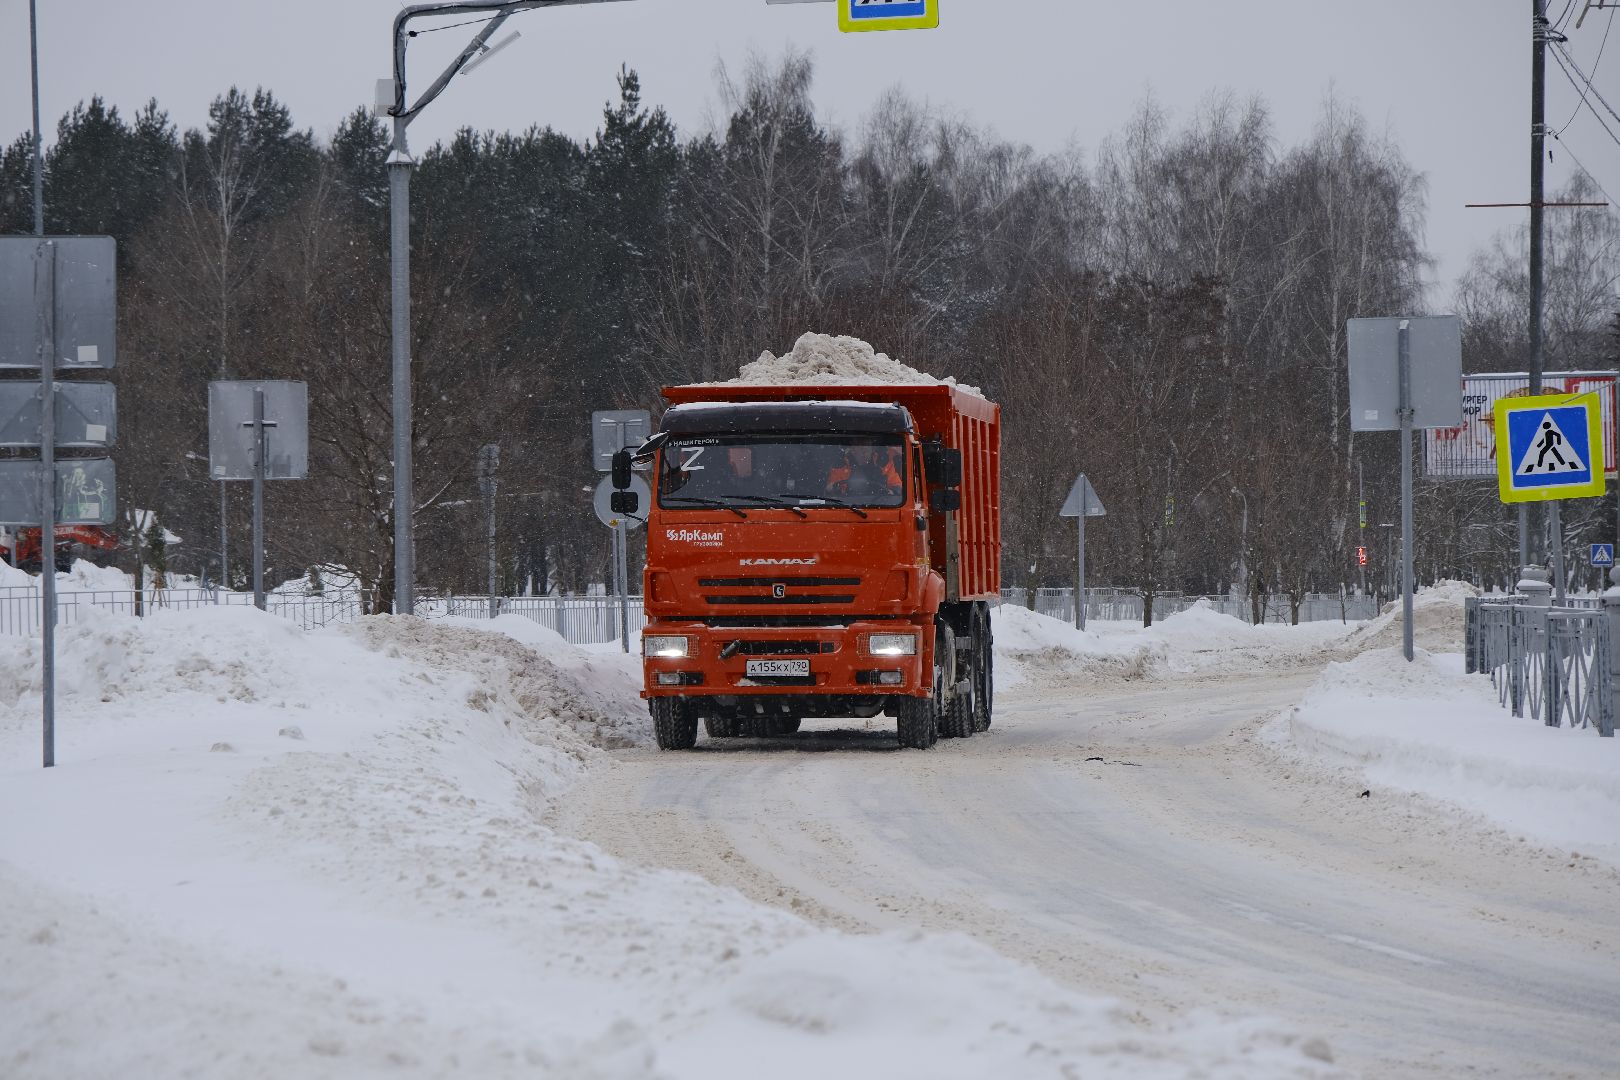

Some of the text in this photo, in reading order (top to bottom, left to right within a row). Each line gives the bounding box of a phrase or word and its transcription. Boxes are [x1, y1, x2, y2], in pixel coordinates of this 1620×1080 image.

[681, 447, 705, 472] Z
[679, 529, 723, 542] ЯрКамп
[739, 558, 817, 566] KAMAZ
